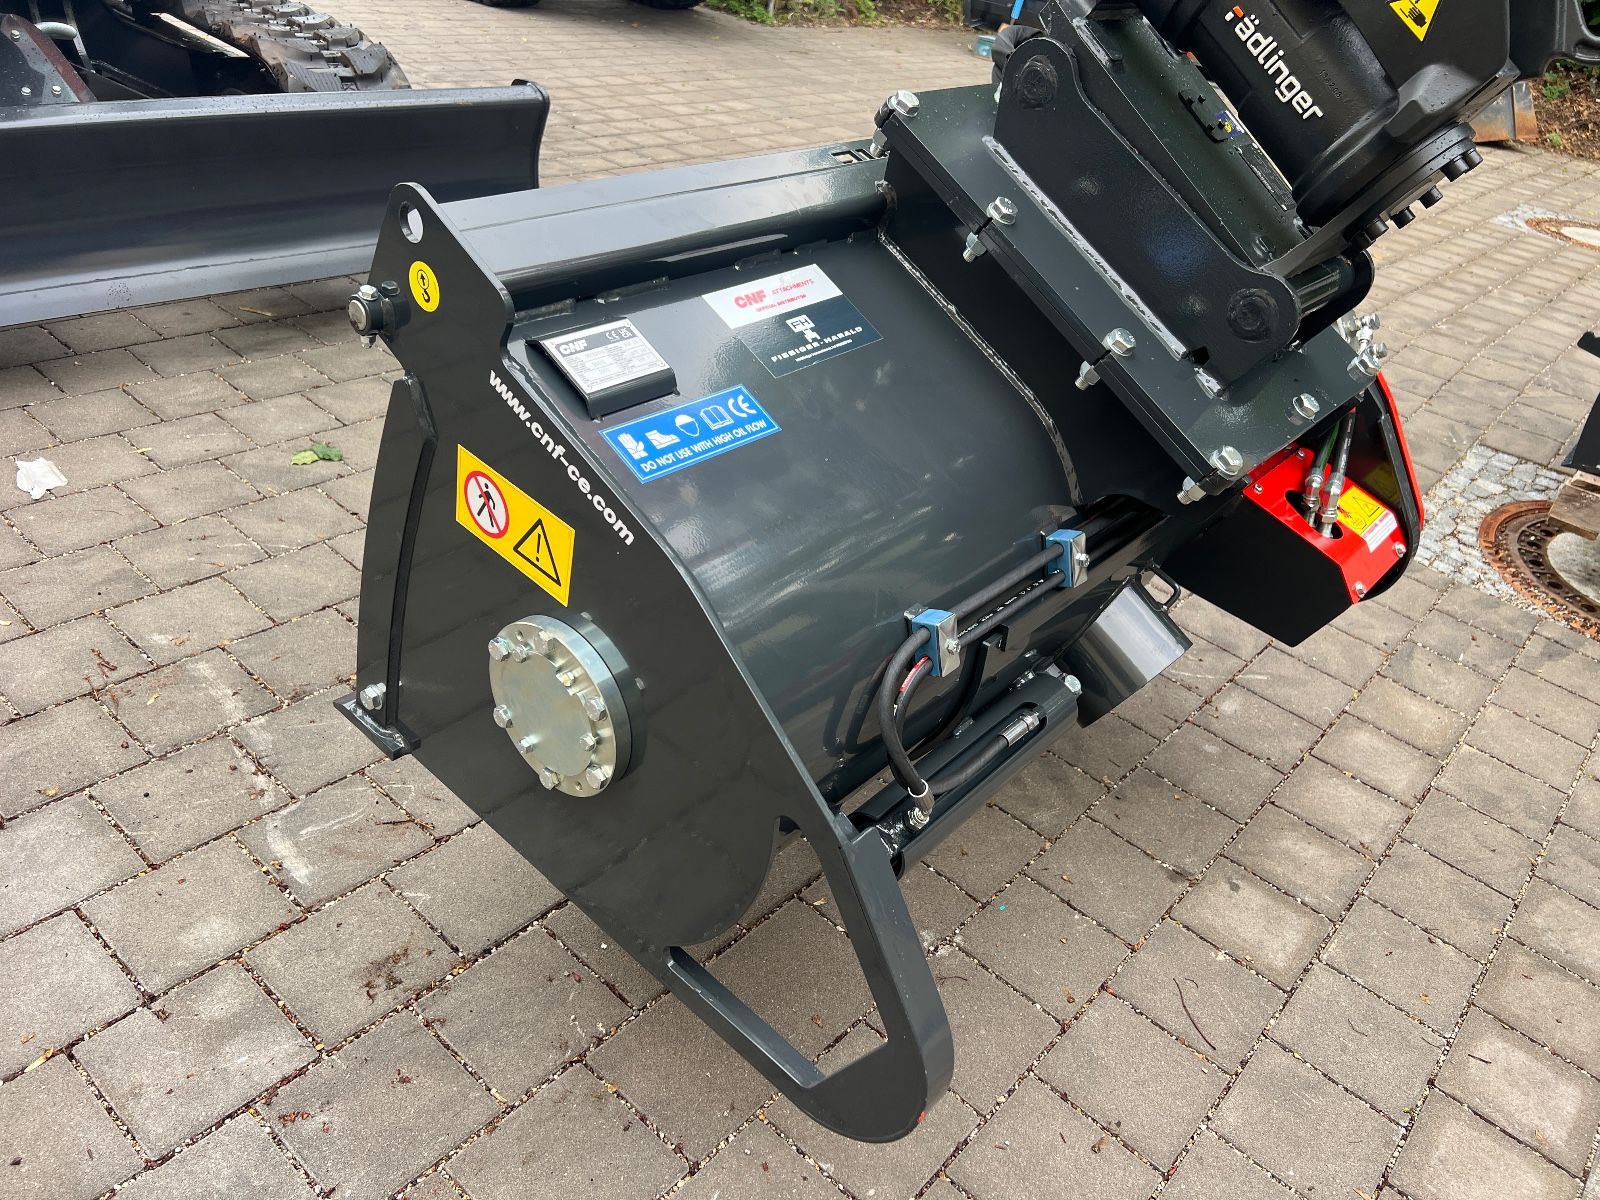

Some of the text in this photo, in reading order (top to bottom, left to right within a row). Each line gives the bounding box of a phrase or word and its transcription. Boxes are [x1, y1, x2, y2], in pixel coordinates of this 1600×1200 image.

[1225, 5, 1324, 120] rädlinger
[734, 278, 814, 308] CNF ATTACHMENTS
[559, 339, 588, 355] CNF
[489, 369, 635, 546] www.cnf-ce.com
[640, 419, 767, 472] DO NOT USE WITH HIGH OIL FLOW
